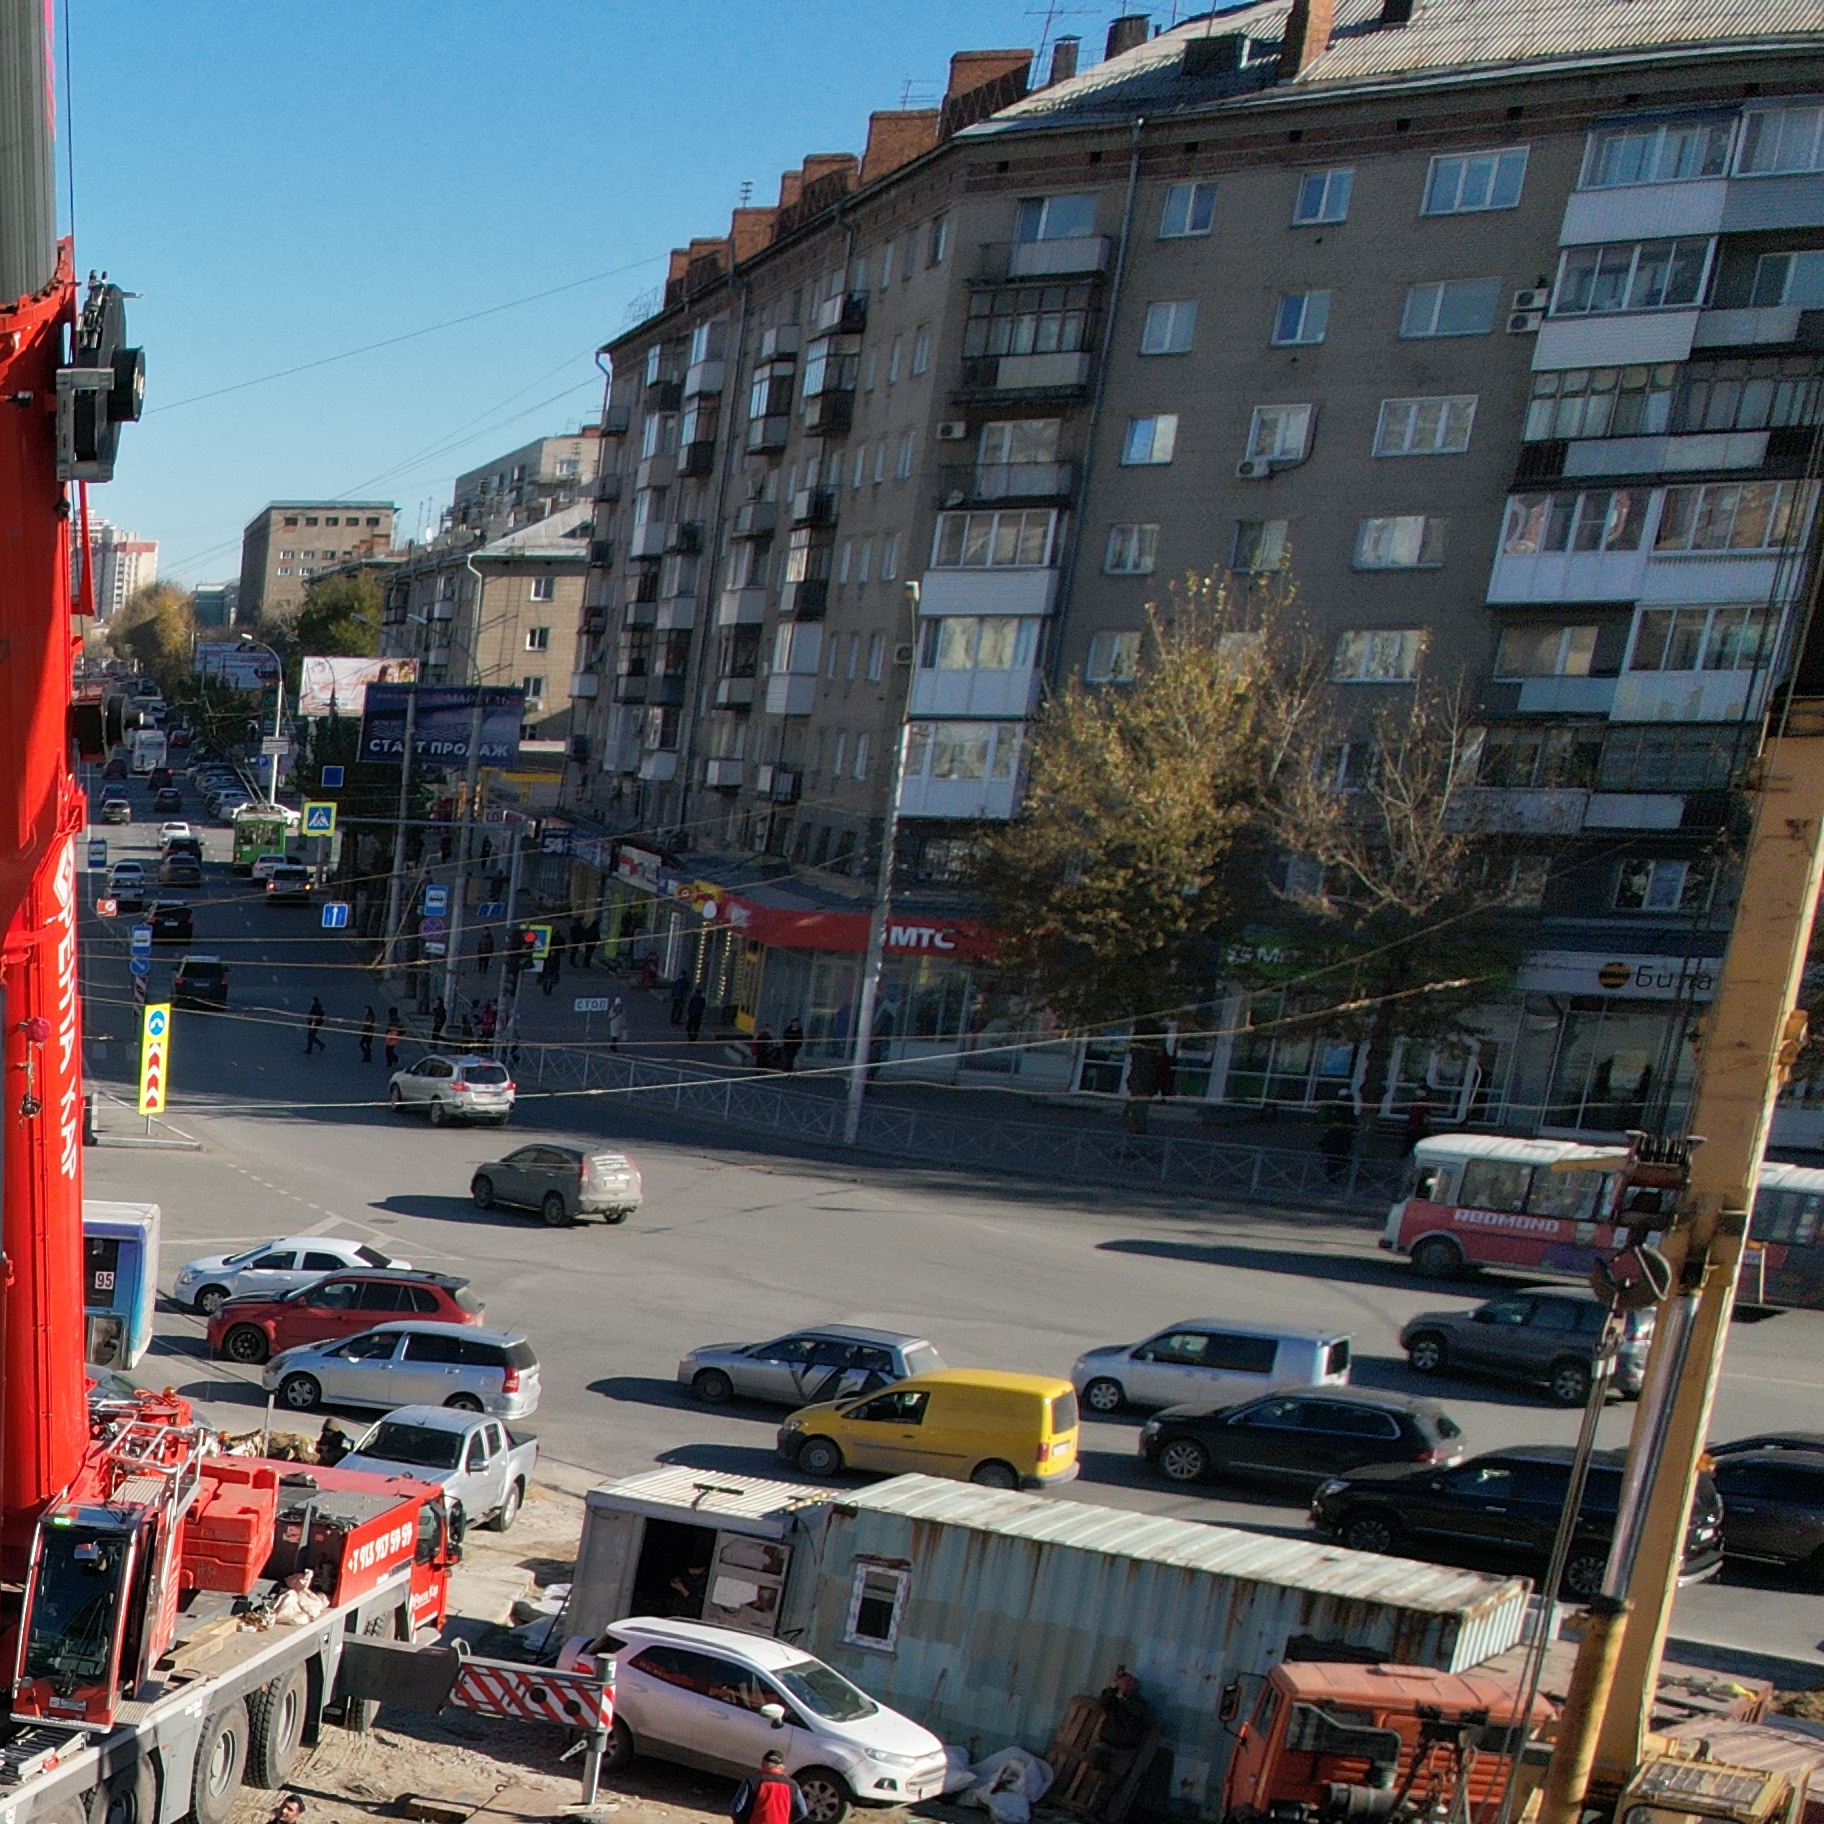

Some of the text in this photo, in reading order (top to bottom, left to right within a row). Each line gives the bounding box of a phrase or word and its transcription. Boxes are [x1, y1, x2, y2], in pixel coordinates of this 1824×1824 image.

[369, 739, 426, 754] СТАТ
[890, 925, 955, 949] МТС
[58, 899, 77, 1180] РЕНТА КАР
[1454, 1209, 1560, 1233] REDMOND
[97, 1272, 112, 1288] 95
